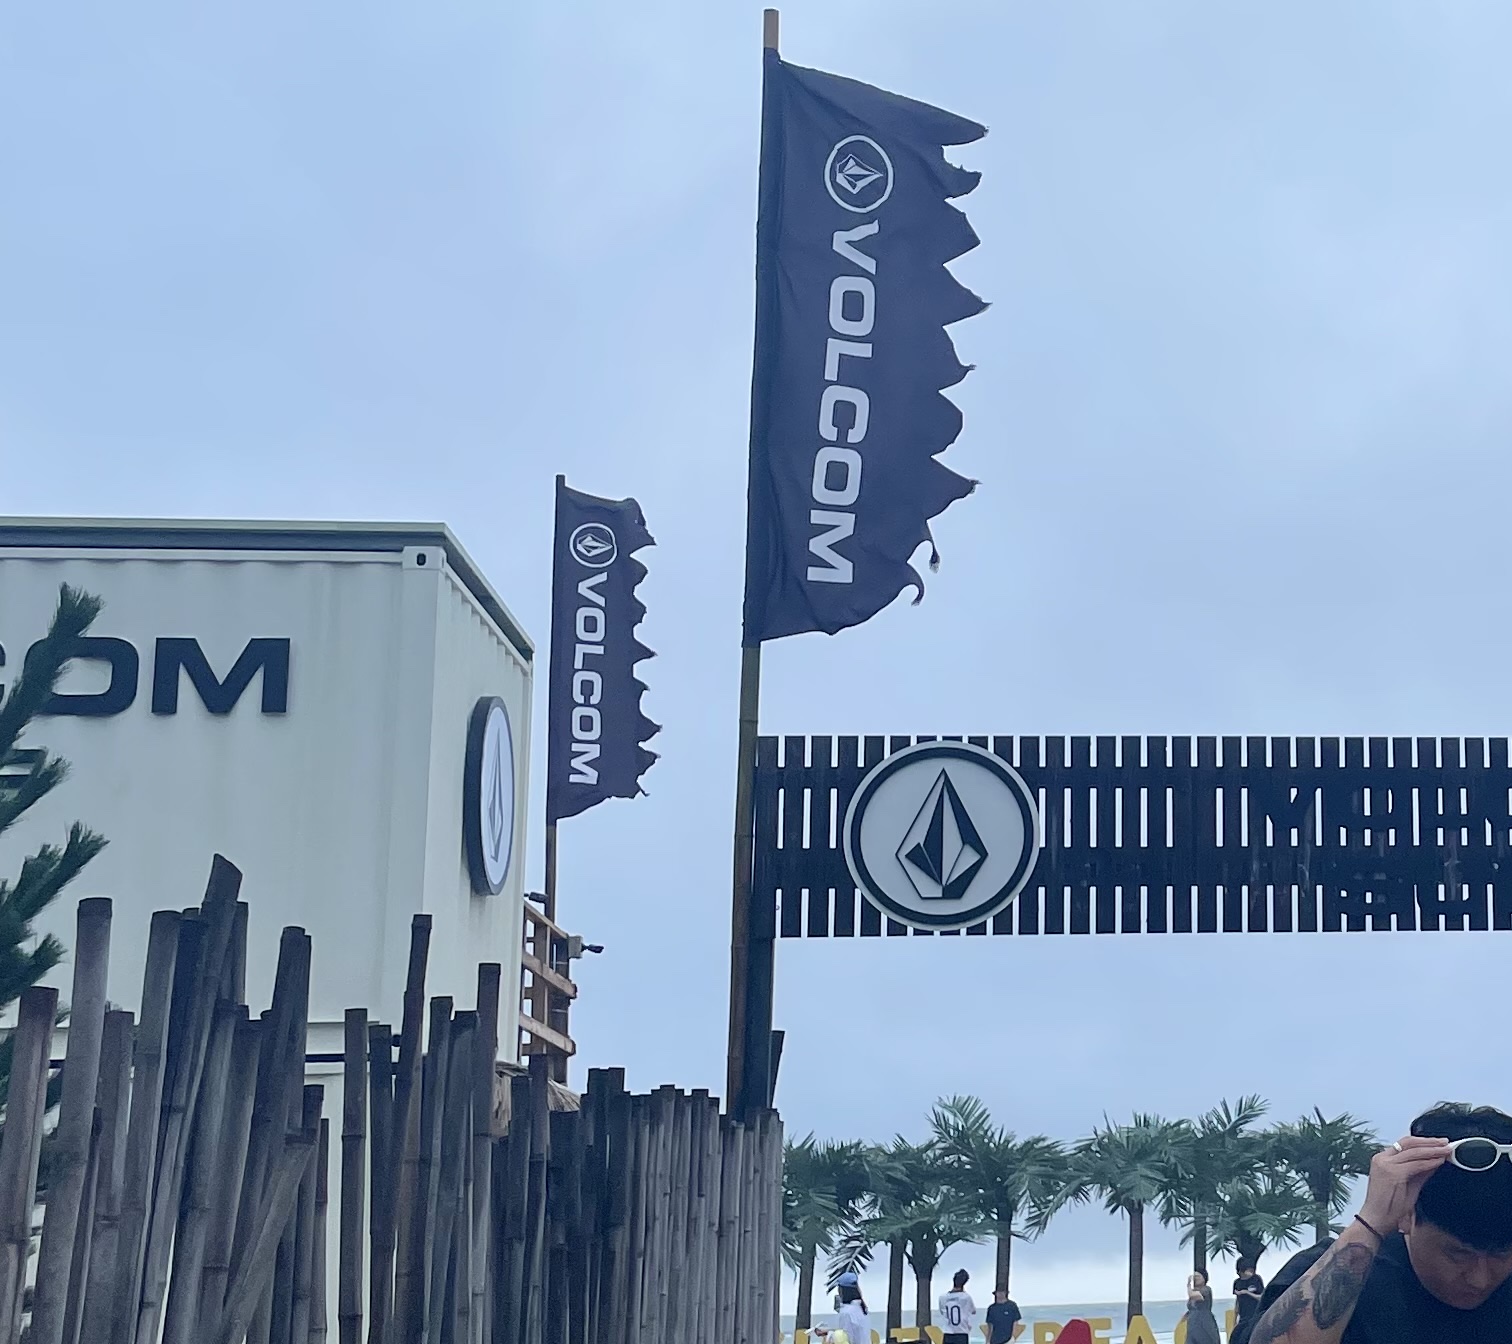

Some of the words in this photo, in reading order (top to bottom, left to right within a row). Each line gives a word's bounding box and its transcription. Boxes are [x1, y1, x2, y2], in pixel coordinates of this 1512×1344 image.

[806, 219, 881, 585] VOLCOM
[0, 636, 291, 717] OM
[568, 571, 609, 786] VOLCOM
[945, 1305, 961, 1326] 10
